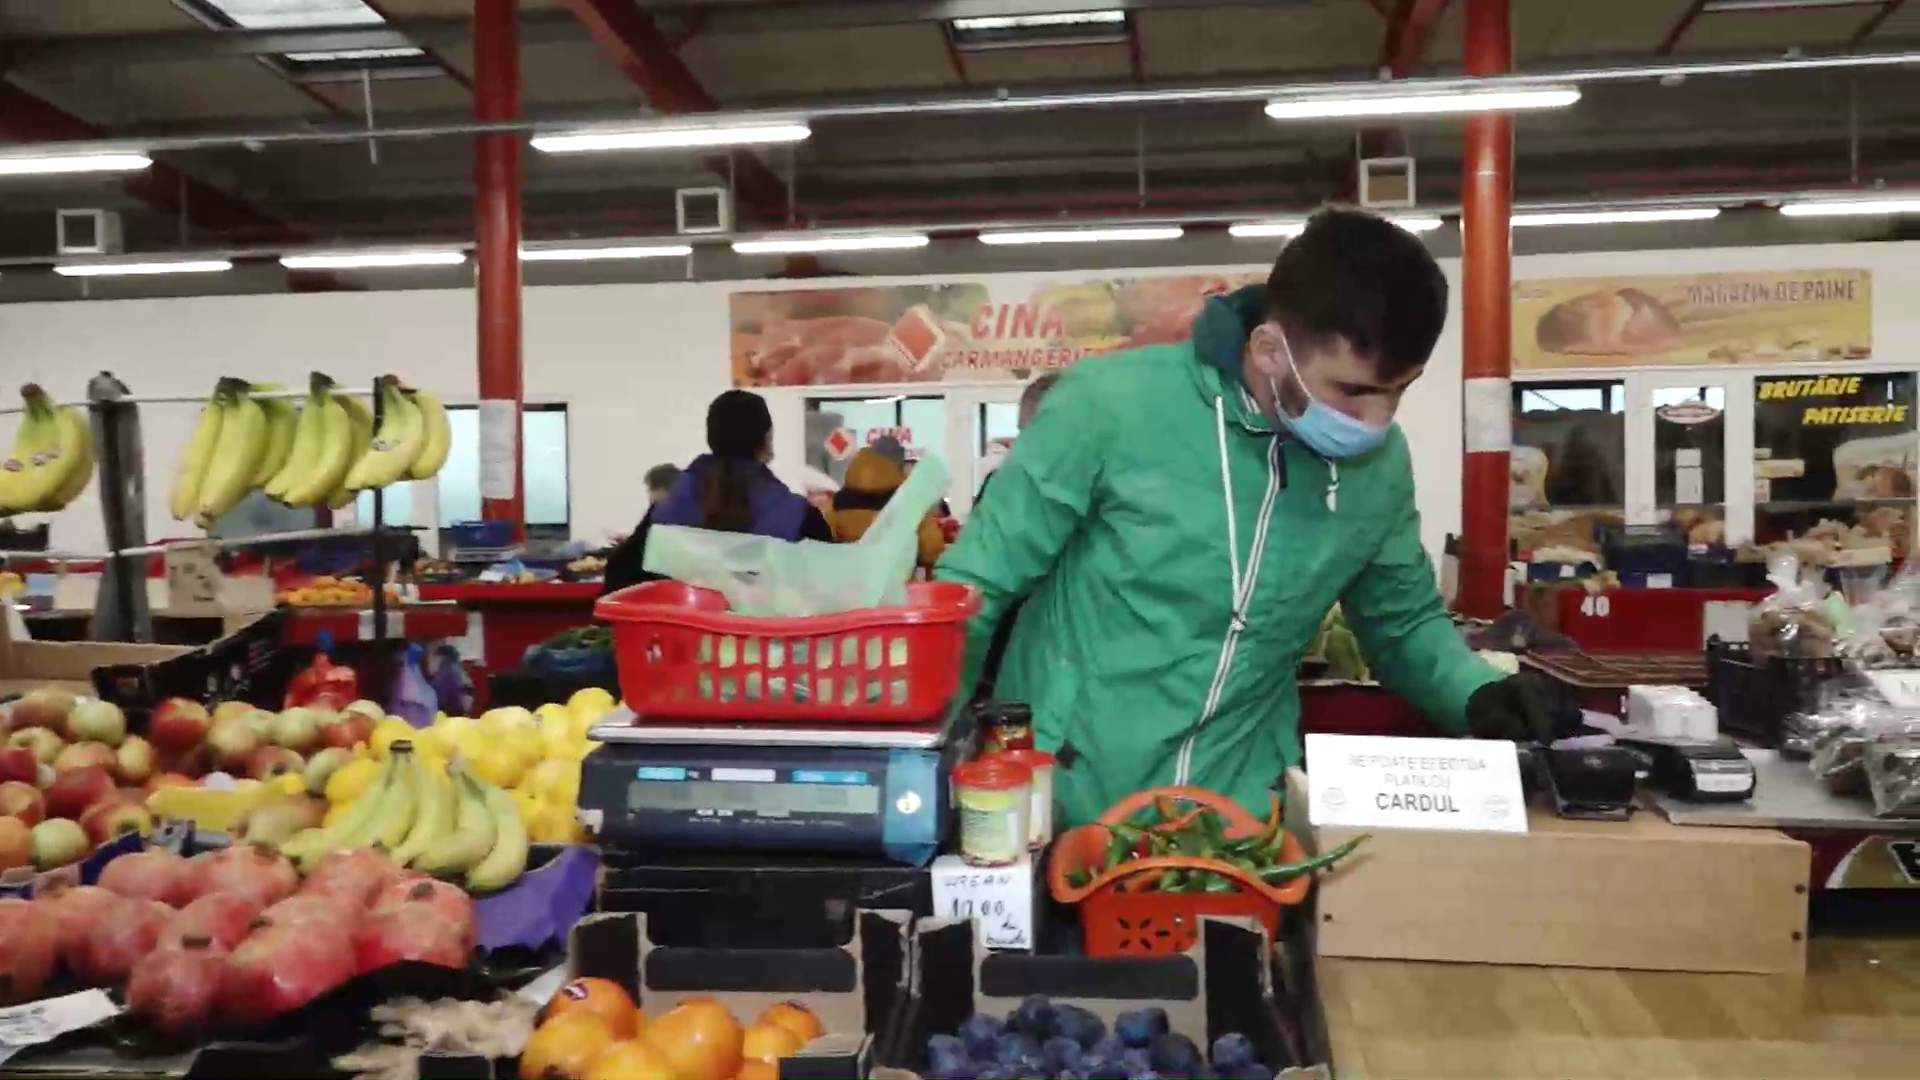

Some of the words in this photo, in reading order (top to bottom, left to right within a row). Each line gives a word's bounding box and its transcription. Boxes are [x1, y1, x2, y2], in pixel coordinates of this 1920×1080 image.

[1776, 280, 1799, 302] DE
[970, 302, 1066, 340] CINA
[1580, 595, 1610, 617] 40
[1375, 792, 1461, 813] CARDUL
